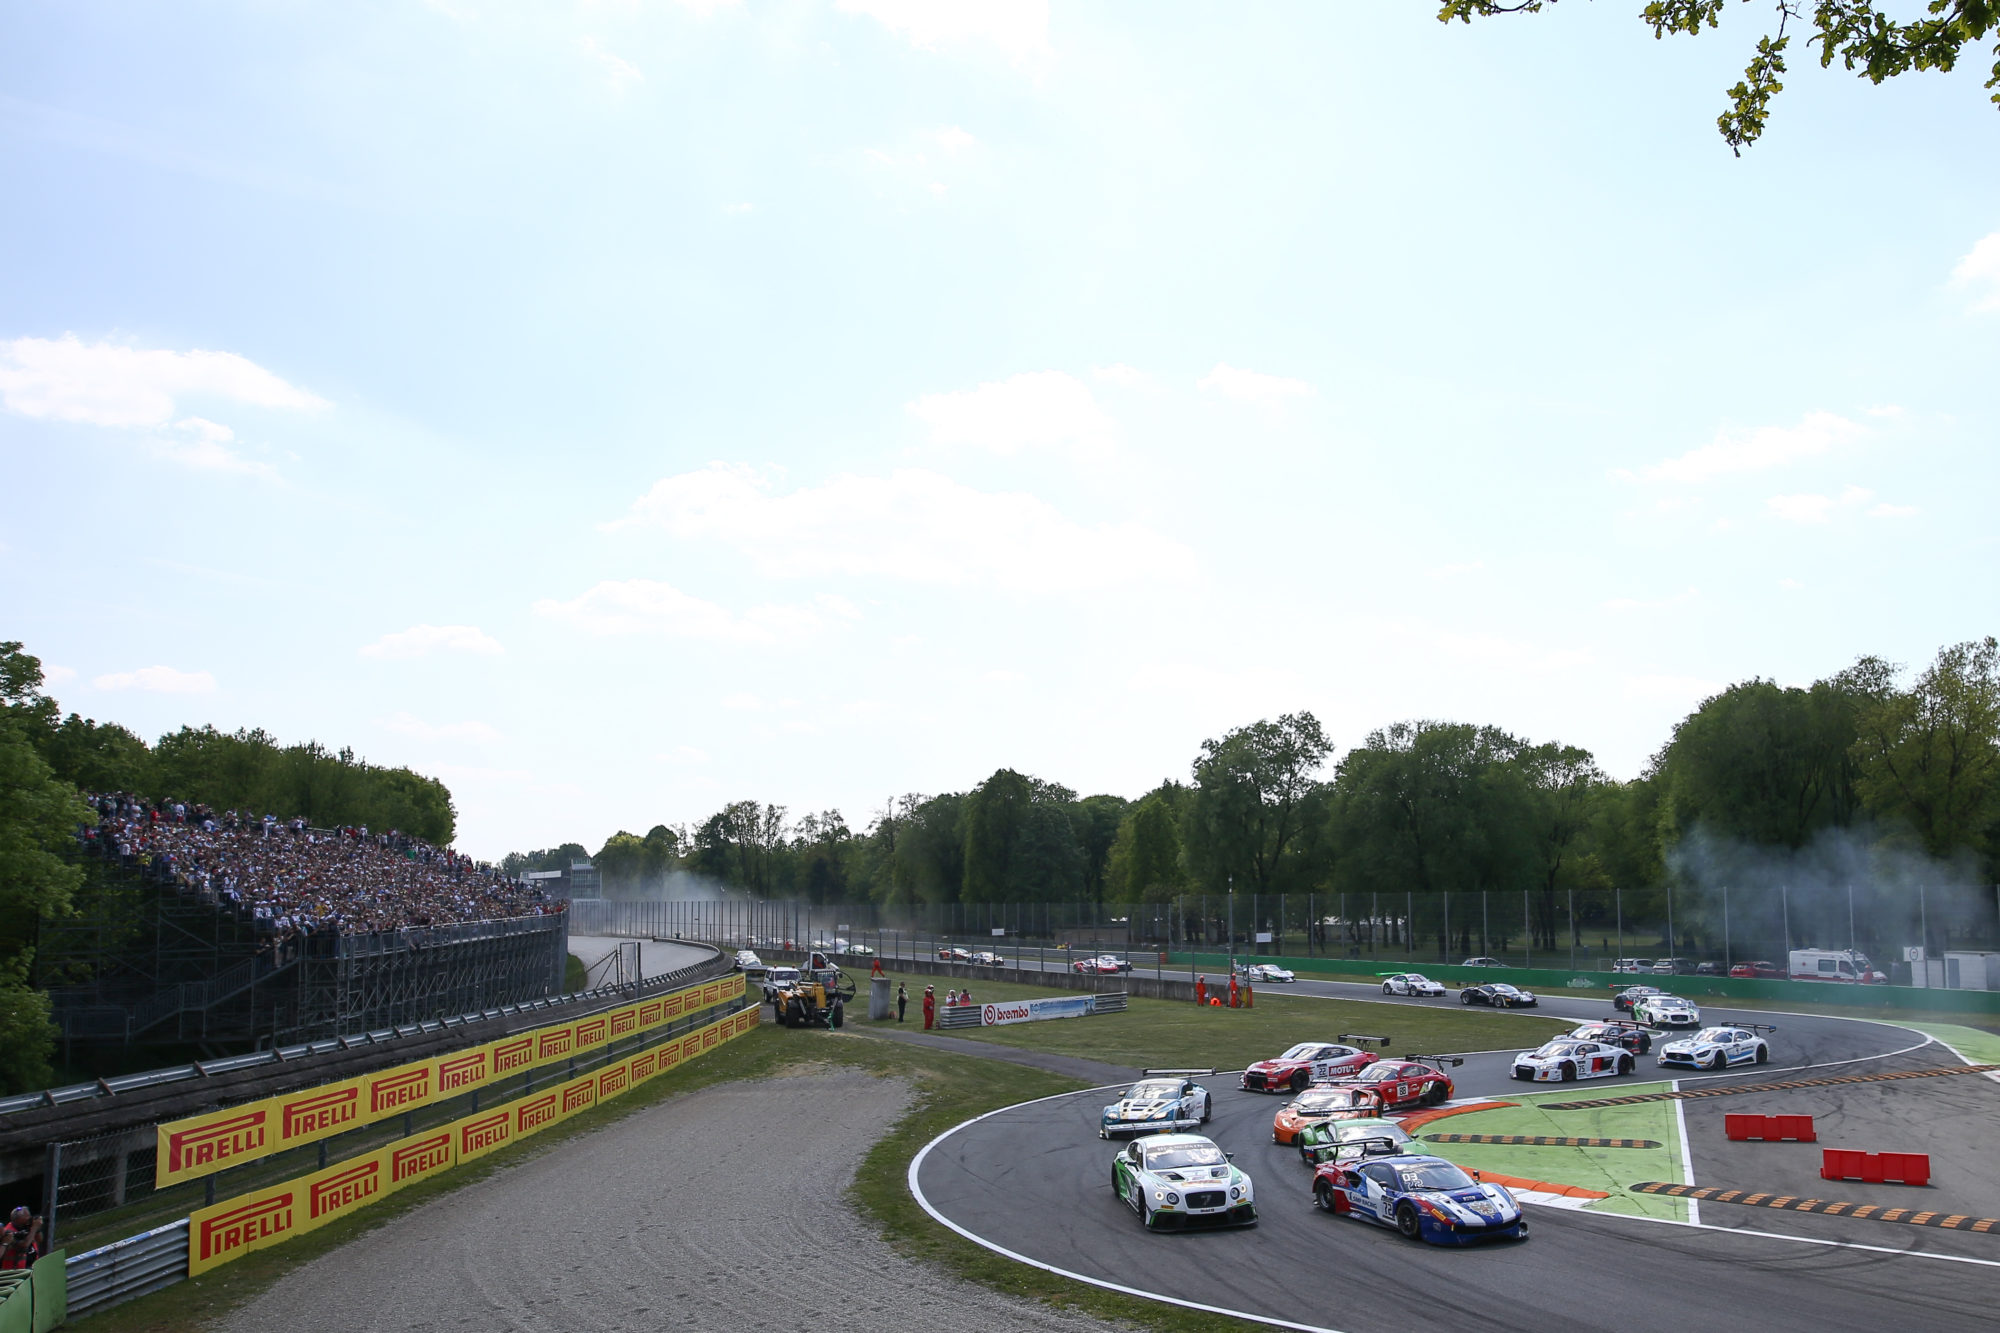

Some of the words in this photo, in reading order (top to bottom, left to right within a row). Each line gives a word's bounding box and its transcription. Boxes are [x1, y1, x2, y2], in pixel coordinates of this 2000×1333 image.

[664, 996, 682, 1018] PIRELLI
[685, 990, 700, 1011] PIRELLI
[703, 985, 718, 1004] PIRELLI
[611, 1010, 635, 1036] PIRELLI
[640, 1002, 661, 1027] PIRELLI
[997, 1006, 1028, 1020] brembo
[539, 1029, 571, 1058] PIRELLI
[576, 1019, 605, 1048] PIRELLI
[683, 1035, 700, 1058] PIRELLI
[703, 1027, 717, 1049] PIRELLI
[494, 1038, 532, 1073] PIRELLI
[632, 1054, 654, 1082] PIRELLI
[659, 1043, 680, 1070] PIRELLI
[1578, 1065, 1585, 1073] 75
[439, 1053, 485, 1092] PIRELLI
[600, 1065, 626, 1097] PIRELLI
[370, 1067, 429, 1113] PIRELLI
[562, 1079, 593, 1113] PIRELLI
[282, 1087, 358, 1139] PIRELLI
[518, 1094, 556, 1132] PIRELLI
[169, 1110, 266, 1173] PIRELLI
[461, 1112, 509, 1155] PIRELLI
[392, 1133, 450, 1182] PIRELLI
[310, 1160, 379, 1219] PIRELLI
[1402, 1173, 1418, 1182] 03
[1201, 1195, 1211, 1206] 7
[1383, 1202, 1393, 1215] 72
[200, 1191, 293, 1261] PIRELLI
